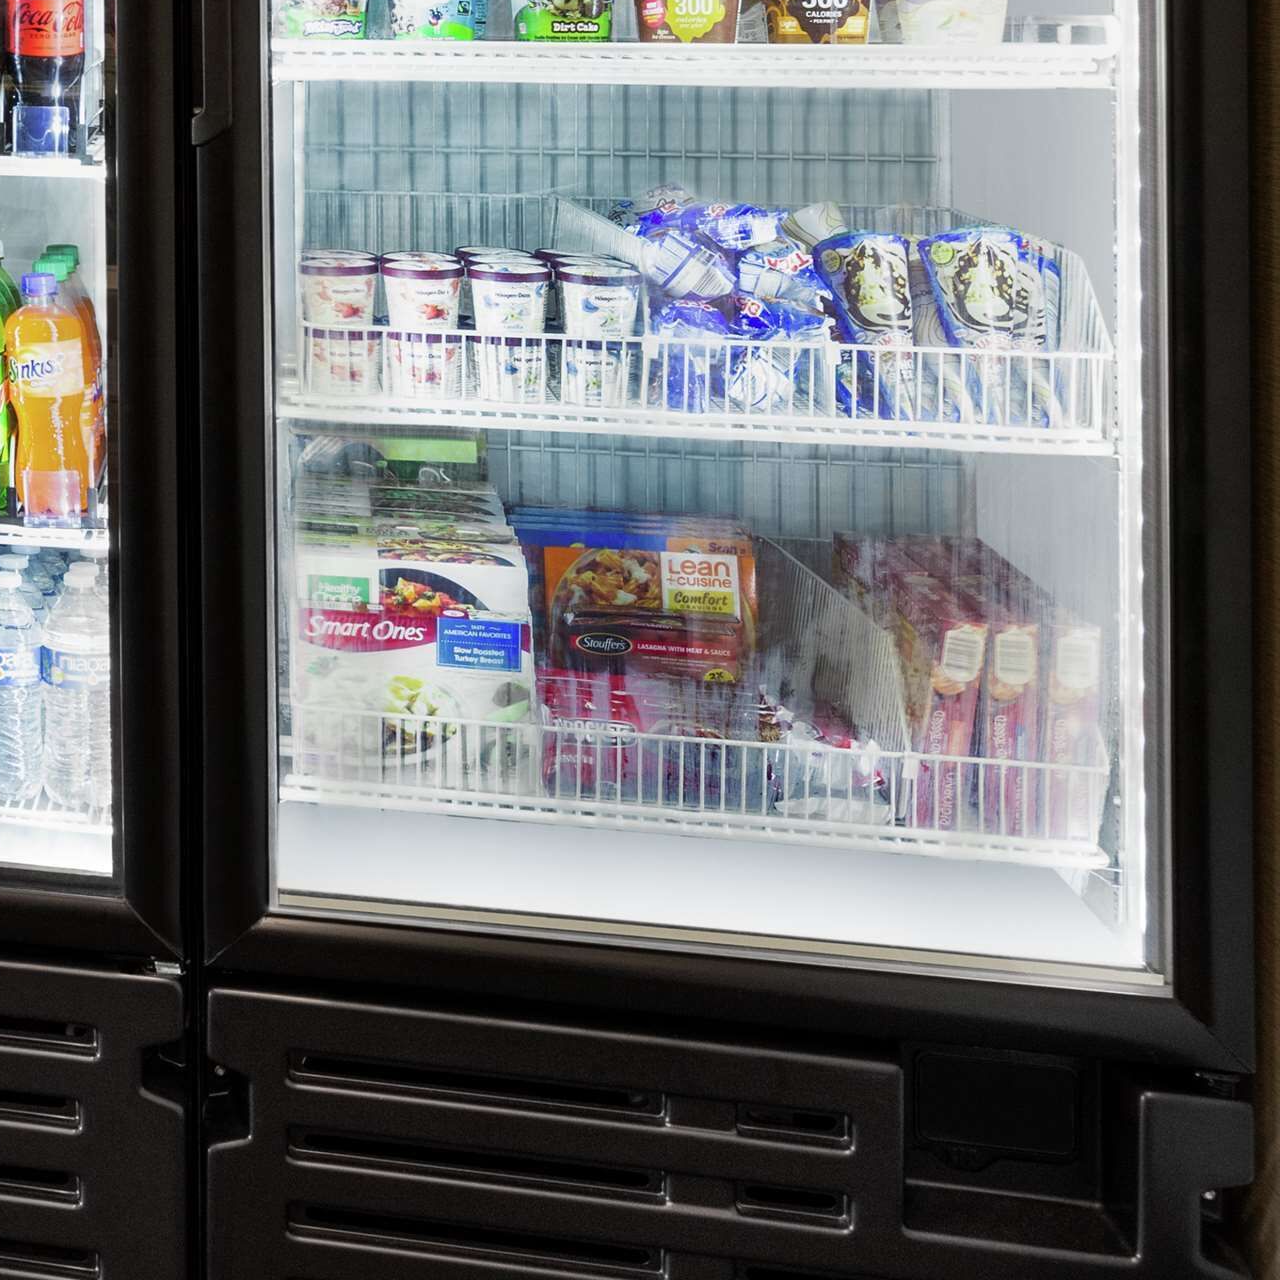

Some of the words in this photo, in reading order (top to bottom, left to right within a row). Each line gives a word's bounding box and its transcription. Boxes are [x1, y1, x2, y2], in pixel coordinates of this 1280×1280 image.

[11, 1, 84, 34] Coca-Cola
[552, 21, 576, 32] Dirt
[576, 21, 599, 32] Cake
[667, 558, 732, 578] Lean
[318, 581, 361, 595] Healthy
[673, 591, 729, 607] Comfort
[304, 615, 370, 640] Smart
[371, 619, 427, 642] Ones
[443, 629, 478, 637] AMERICAN
[478, 631, 512, 640] FAVORITES
[453, 646, 472, 654] Slow
[583, 636, 627, 651] Stouffer's
[454, 654, 479, 664] Turkey
